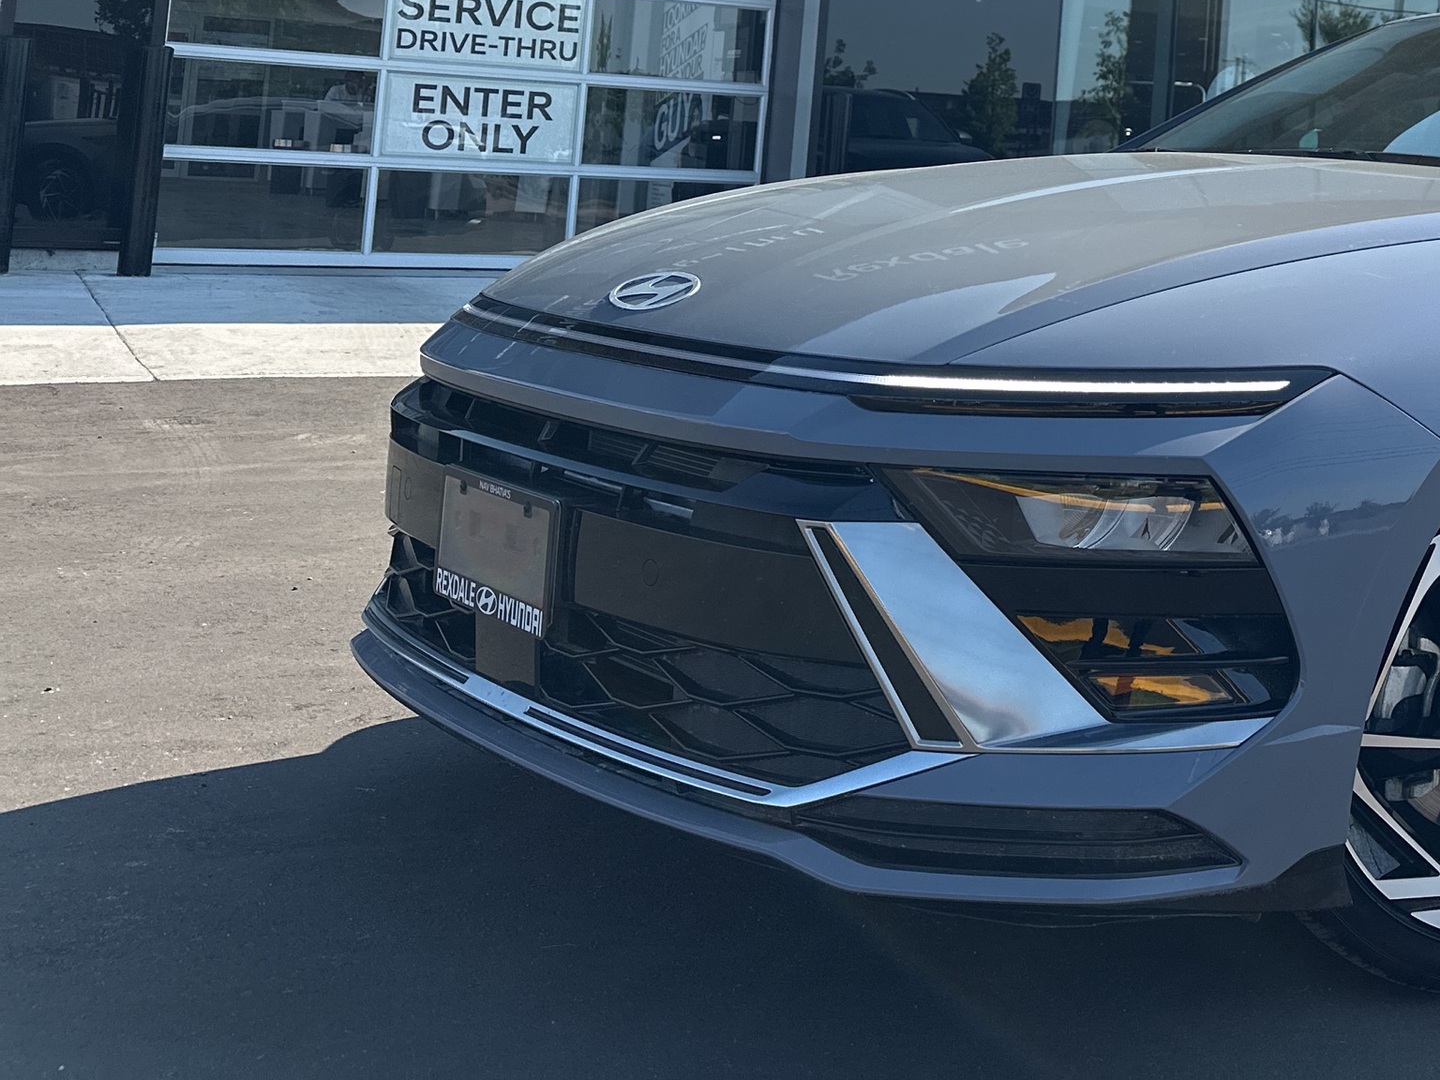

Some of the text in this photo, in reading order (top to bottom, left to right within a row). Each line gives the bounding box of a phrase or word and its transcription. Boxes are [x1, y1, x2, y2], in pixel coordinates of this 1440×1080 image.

[395, 27, 578, 62] DRIVE-THRU
[412, 82, 554, 122] ENTER
[654, 93, 694, 151] GUY
[421, 119, 540, 155] ONLY
[435, 567, 543, 638] REXDALE HYUNDAI
